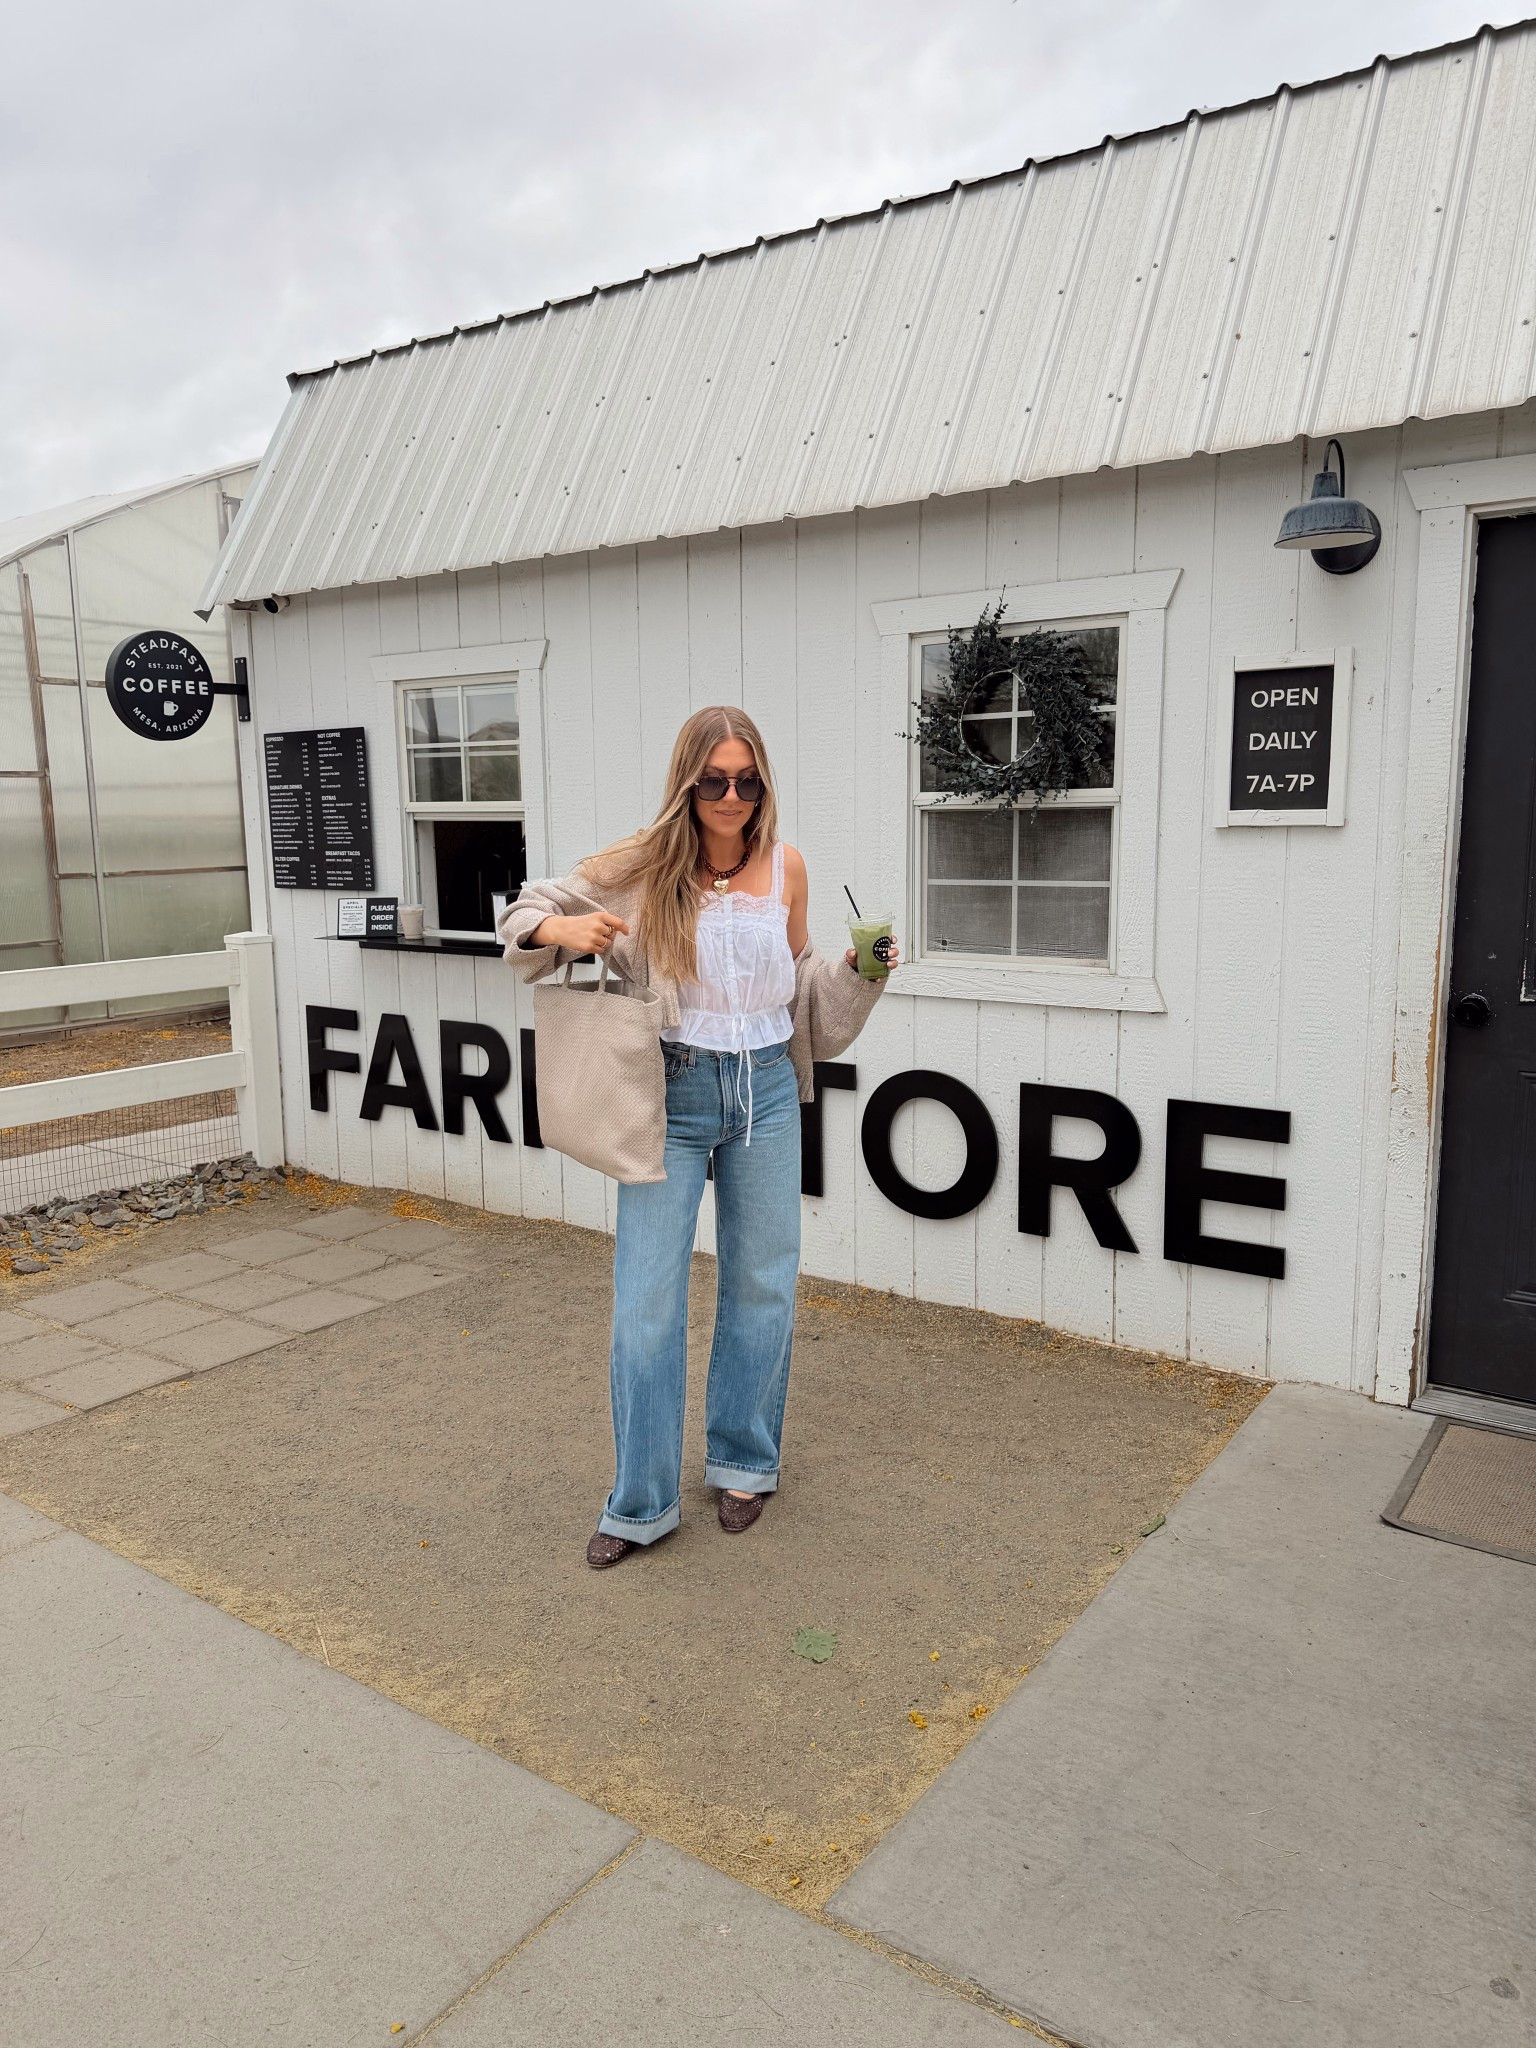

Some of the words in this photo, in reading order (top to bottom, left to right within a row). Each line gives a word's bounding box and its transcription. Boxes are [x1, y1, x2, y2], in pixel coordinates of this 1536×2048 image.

[125, 638, 204, 674] STEADFAST
[122, 677, 209, 696] COFFEE
[1251, 687, 1319, 708] OPEN
[133, 706, 161, 732] MESA,
[165, 708, 204, 732] ARIZONA
[1249, 731, 1317, 751] DAILY
[1246, 774, 1315, 793] 7A-7P
[306, 1005, 544, 1149] FAR
[707, 1061, 1292, 1280] TORE
